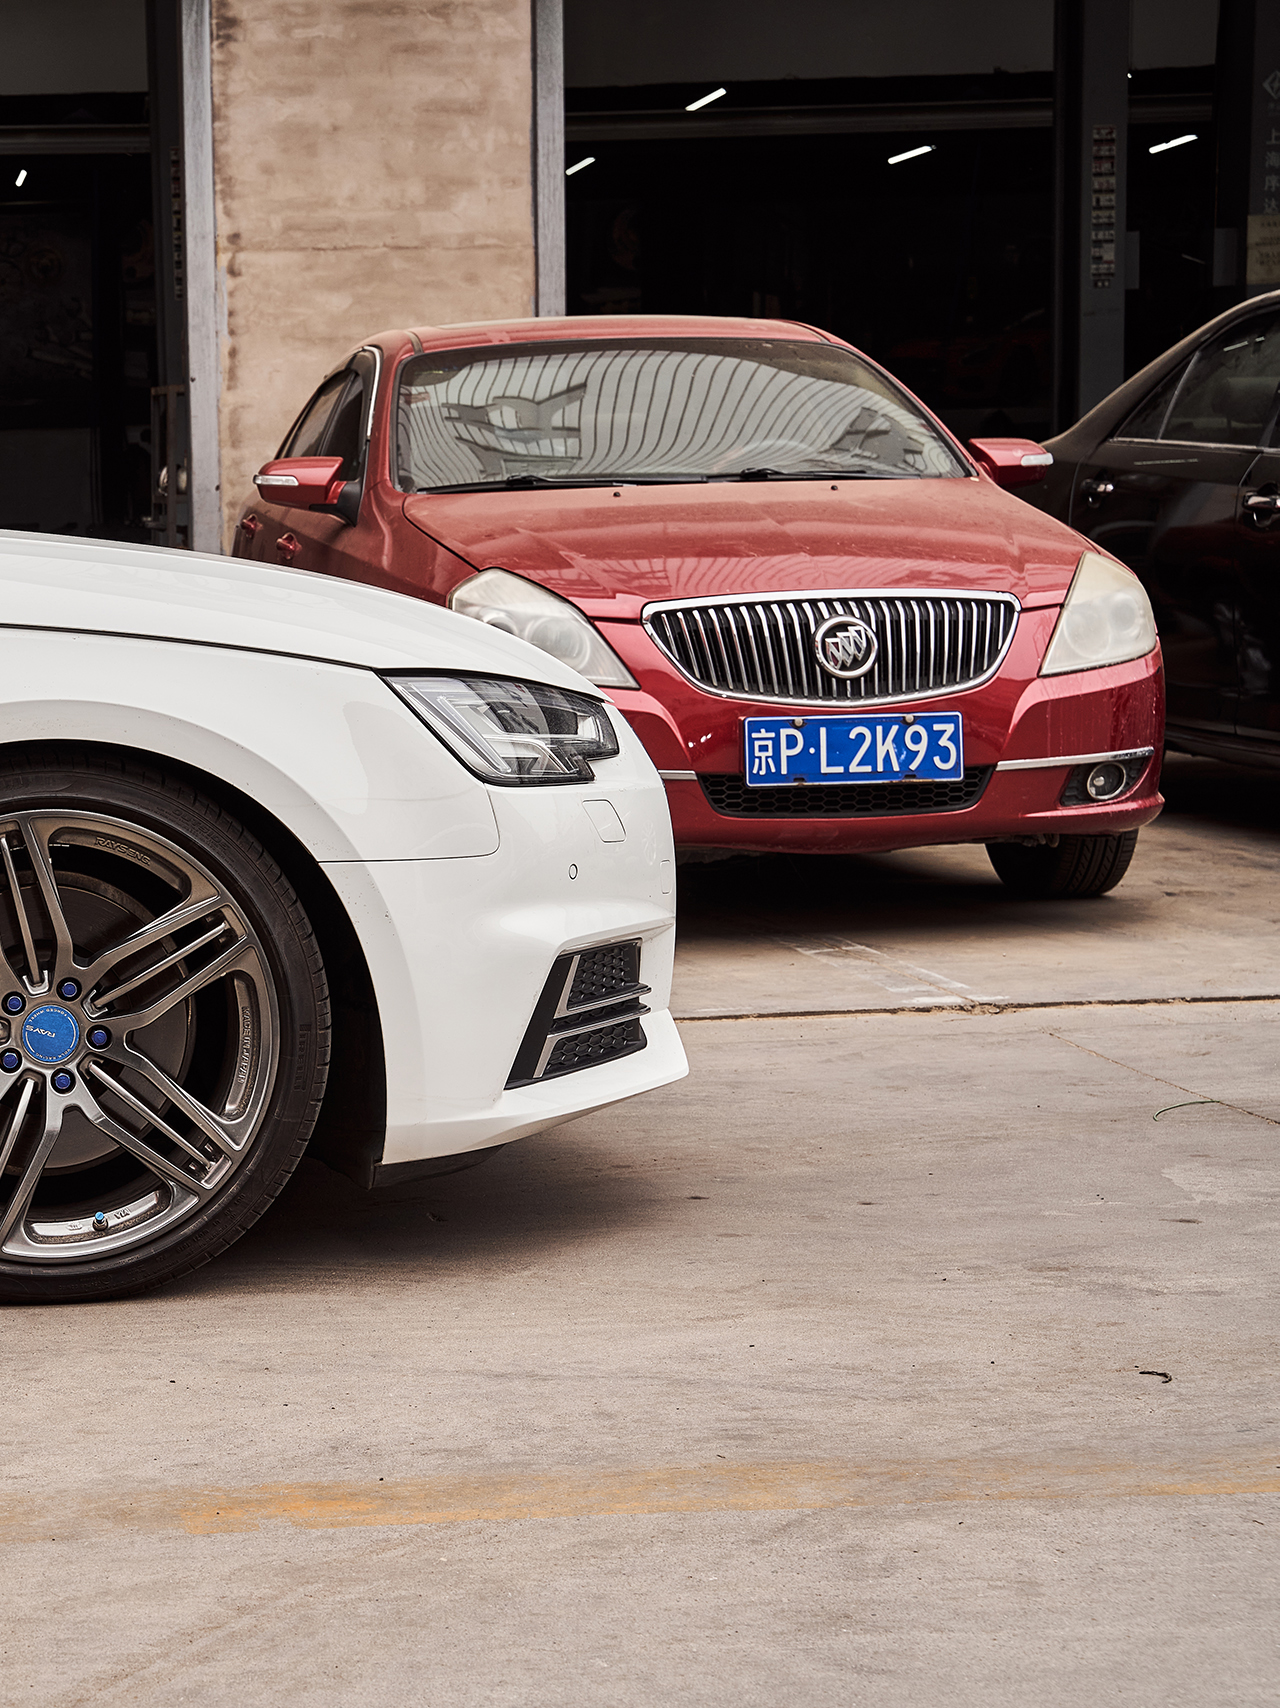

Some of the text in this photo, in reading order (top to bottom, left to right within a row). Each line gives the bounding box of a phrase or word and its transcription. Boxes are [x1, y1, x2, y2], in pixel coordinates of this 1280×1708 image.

[751, 723, 958, 776] 京P·L2K93
[94, 836, 129, 854] RAYS
[25, 1024, 56, 1038] RAYS
[293, 1023, 312, 1092] PIRELLI
